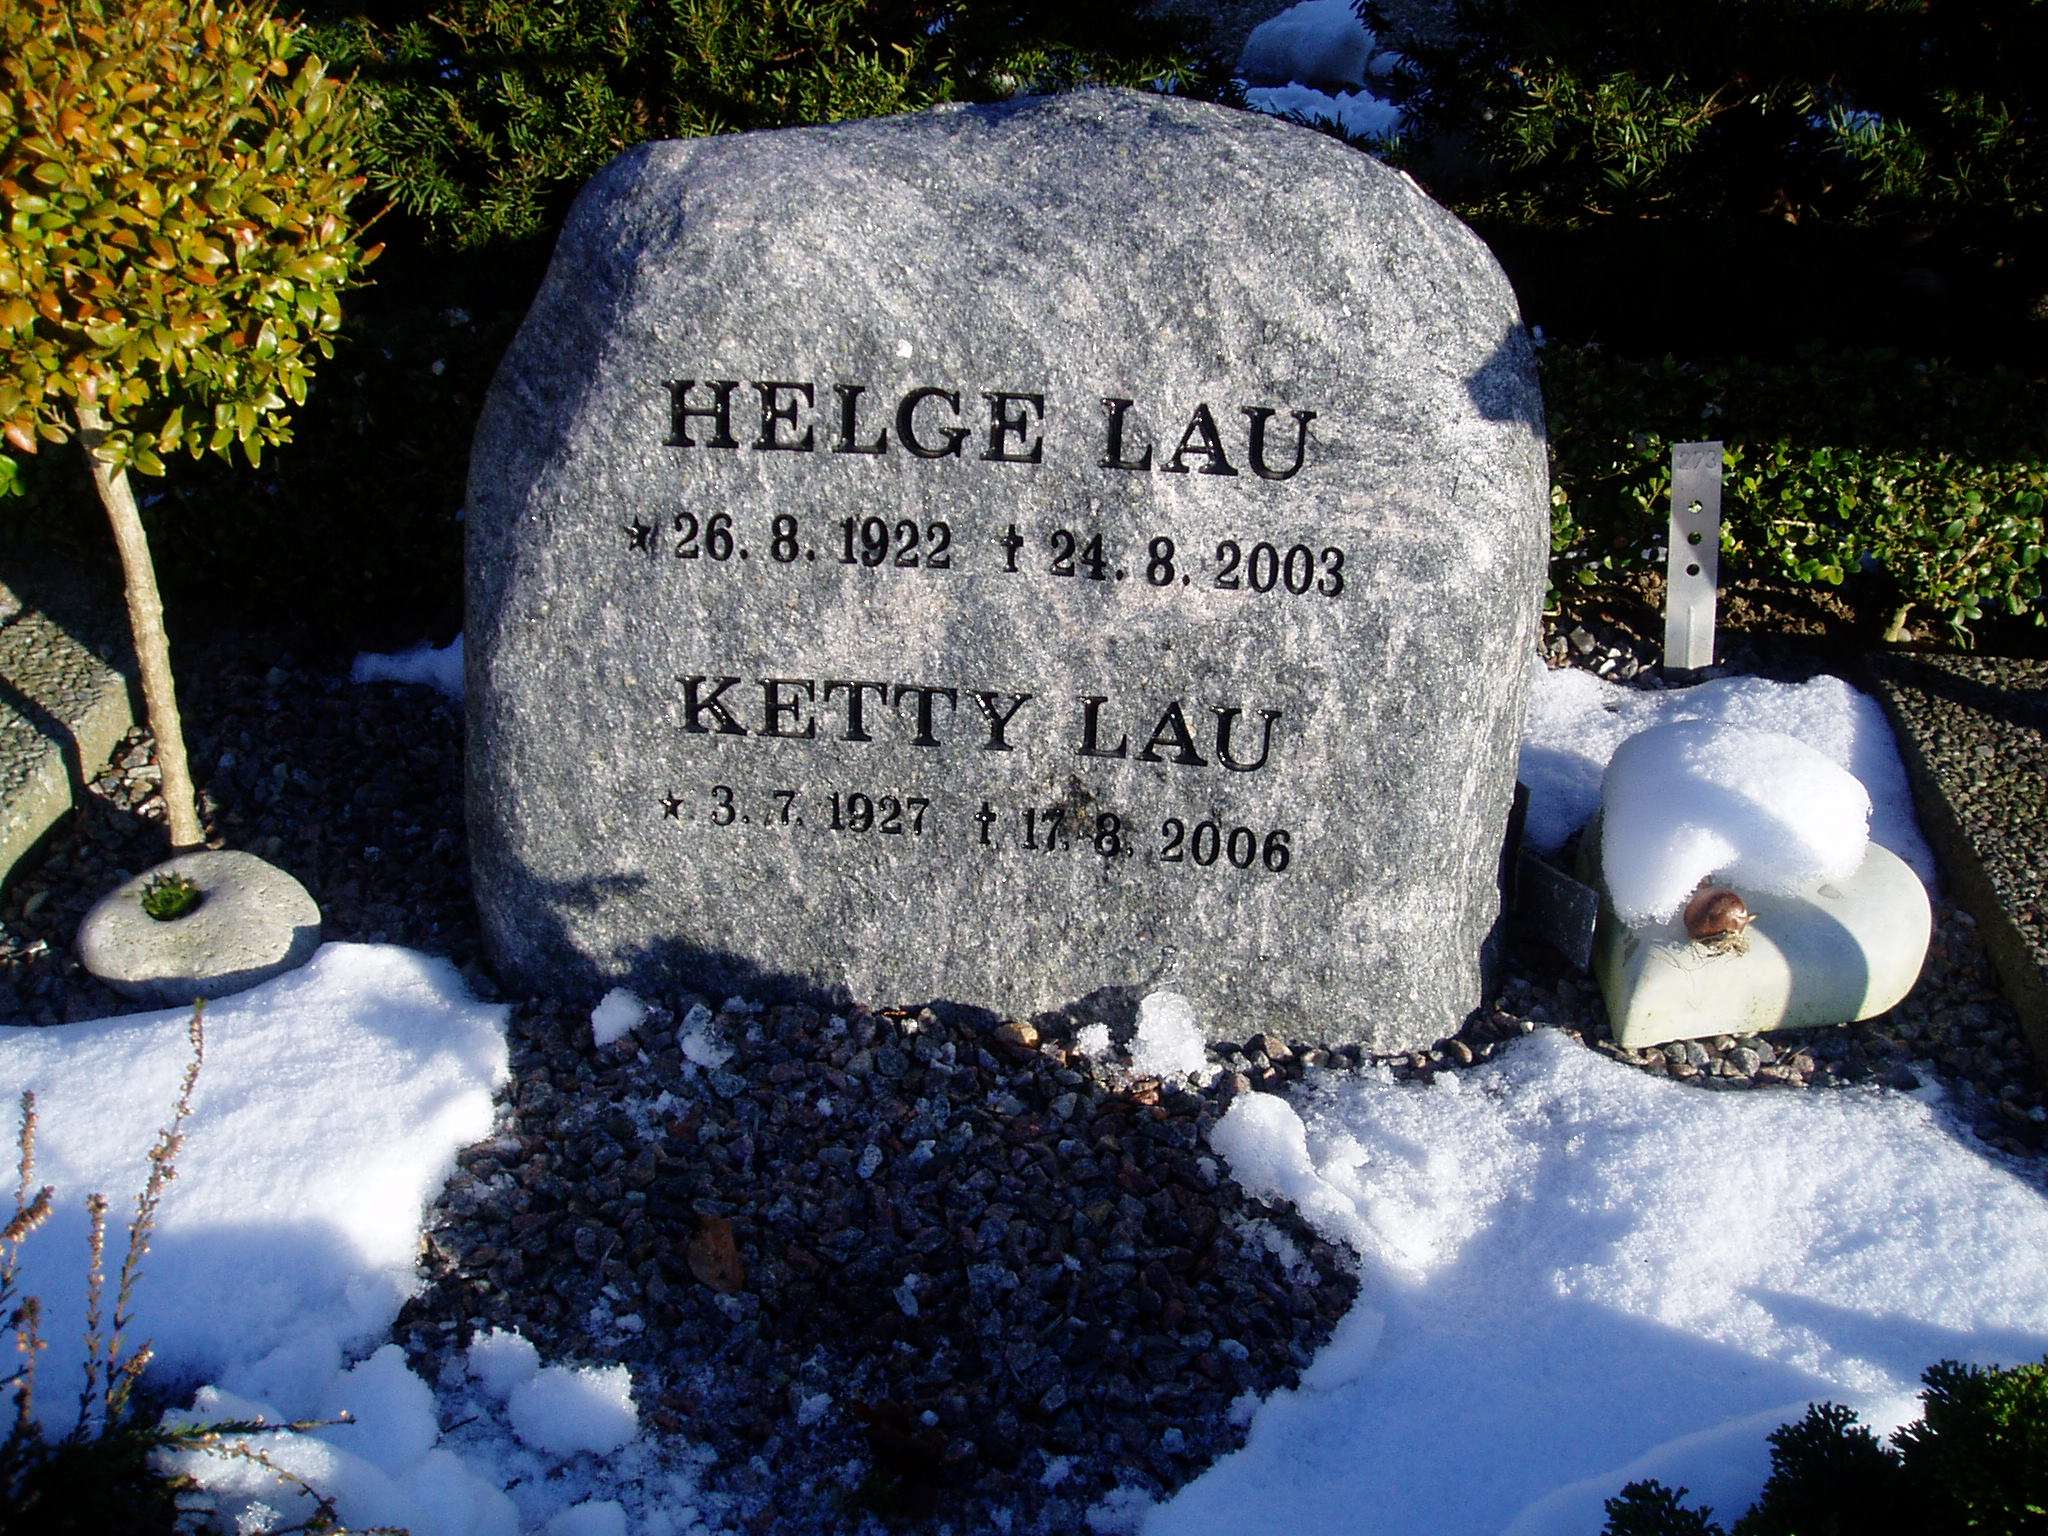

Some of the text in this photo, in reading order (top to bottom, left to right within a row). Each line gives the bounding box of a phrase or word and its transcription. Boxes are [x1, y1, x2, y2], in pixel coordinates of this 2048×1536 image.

[661, 379, 1318, 481] HELGE LAU
[839, 516, 952, 569] 1922
[1215, 540, 1346, 597] 2003
[675, 674, 1282, 772] KETTY LAU
[828, 791, 930, 835] 1927
[1160, 818, 1292, 872] 2006
